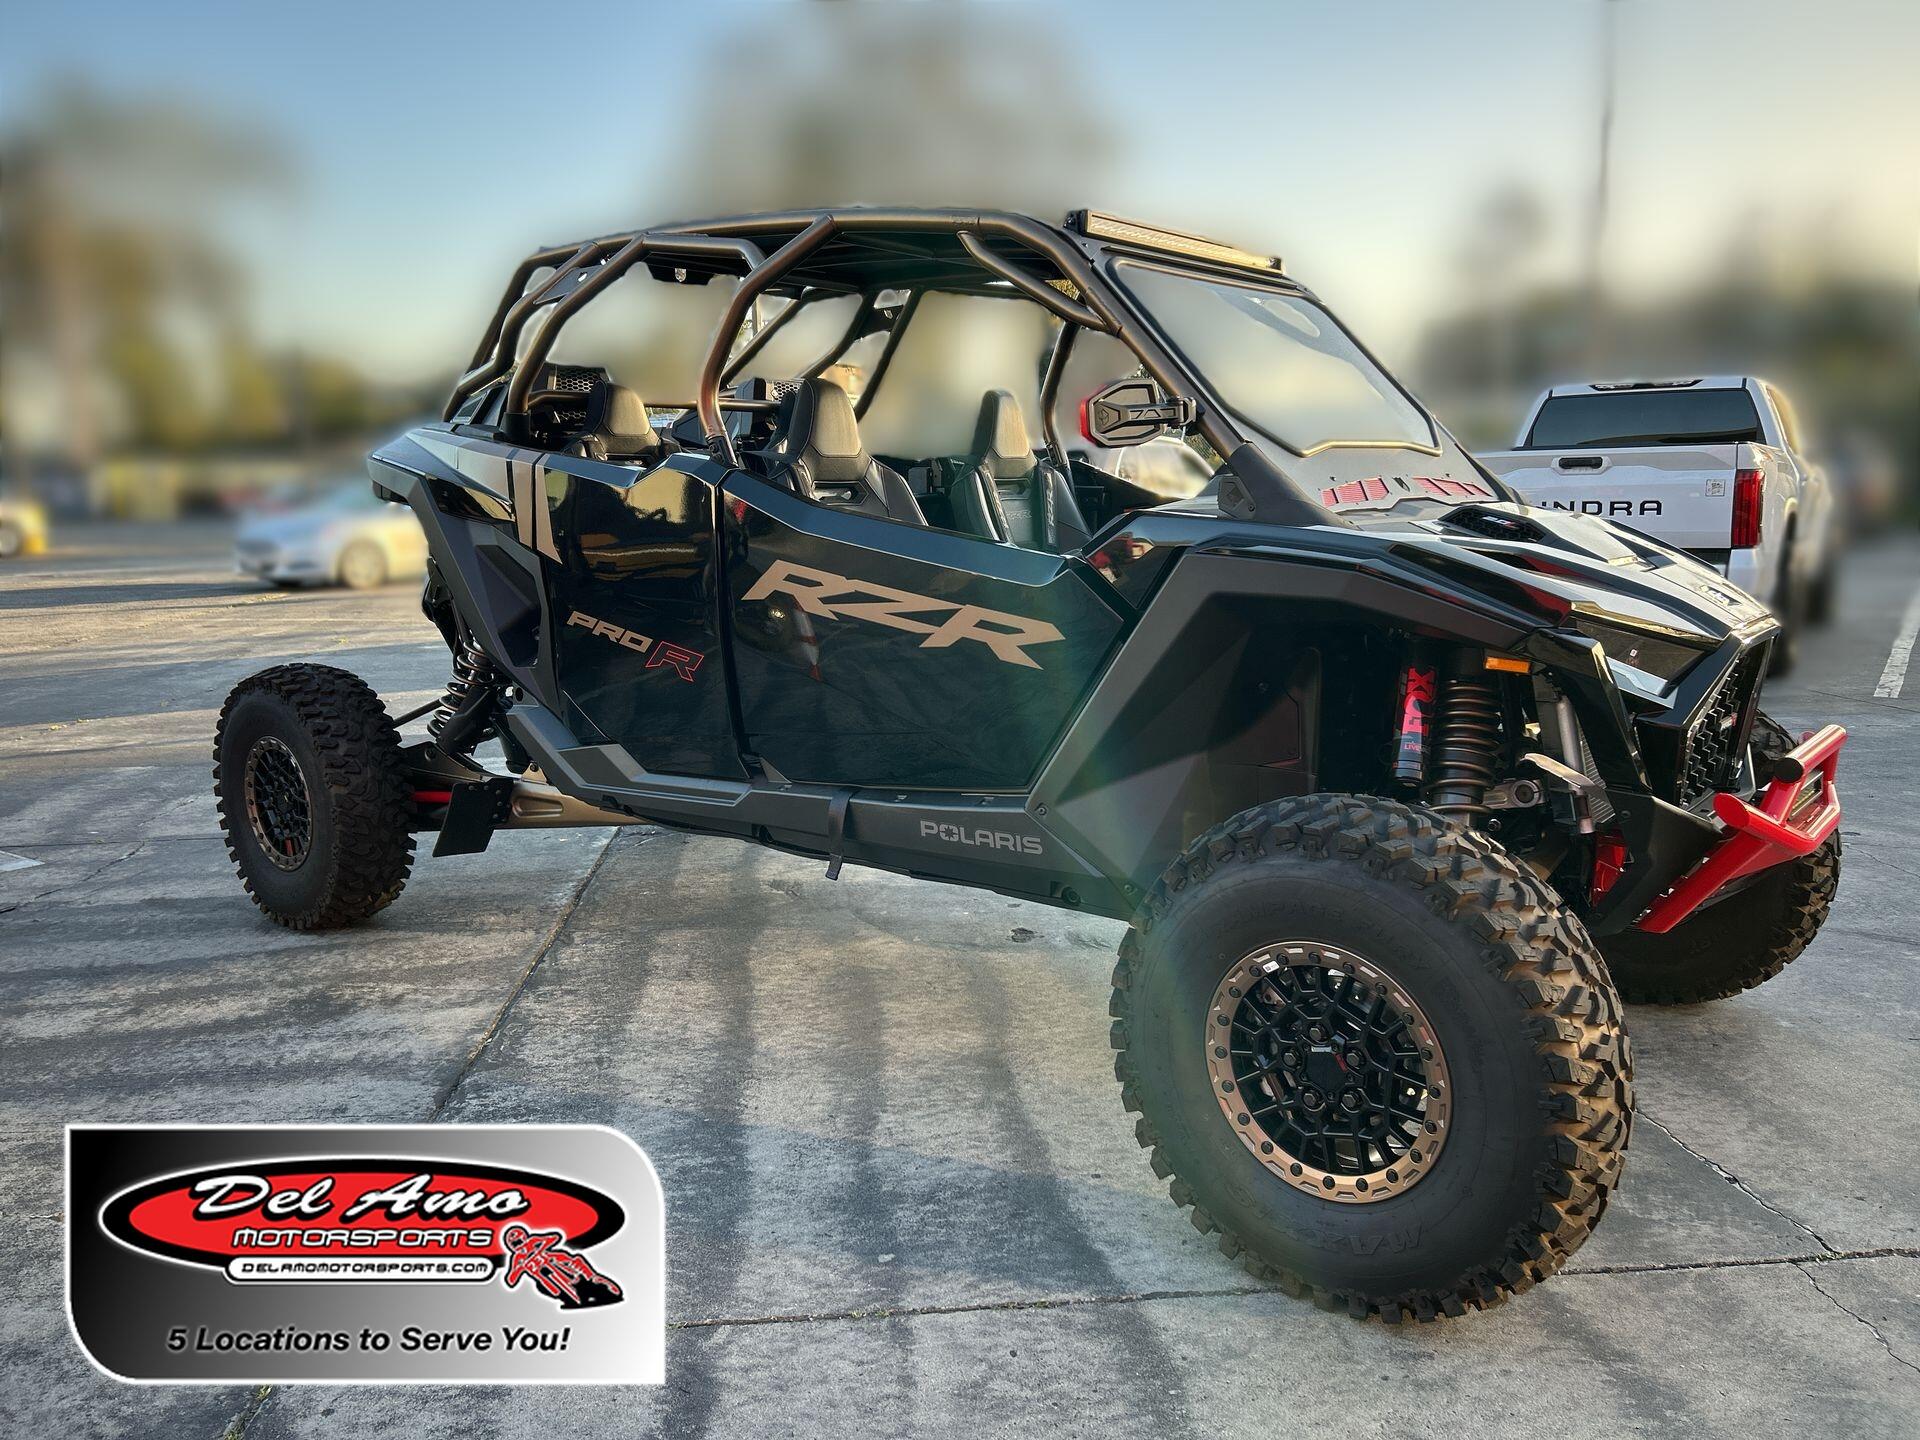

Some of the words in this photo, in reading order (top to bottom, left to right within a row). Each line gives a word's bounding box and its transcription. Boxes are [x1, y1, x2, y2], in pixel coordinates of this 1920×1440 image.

[1541, 500, 1663, 516] NDRA
[742, 560, 1066, 670] RZR
[567, 611, 653, 653] PRO
[645, 641, 704, 682] R
[920, 820, 1043, 855] POLARIS
